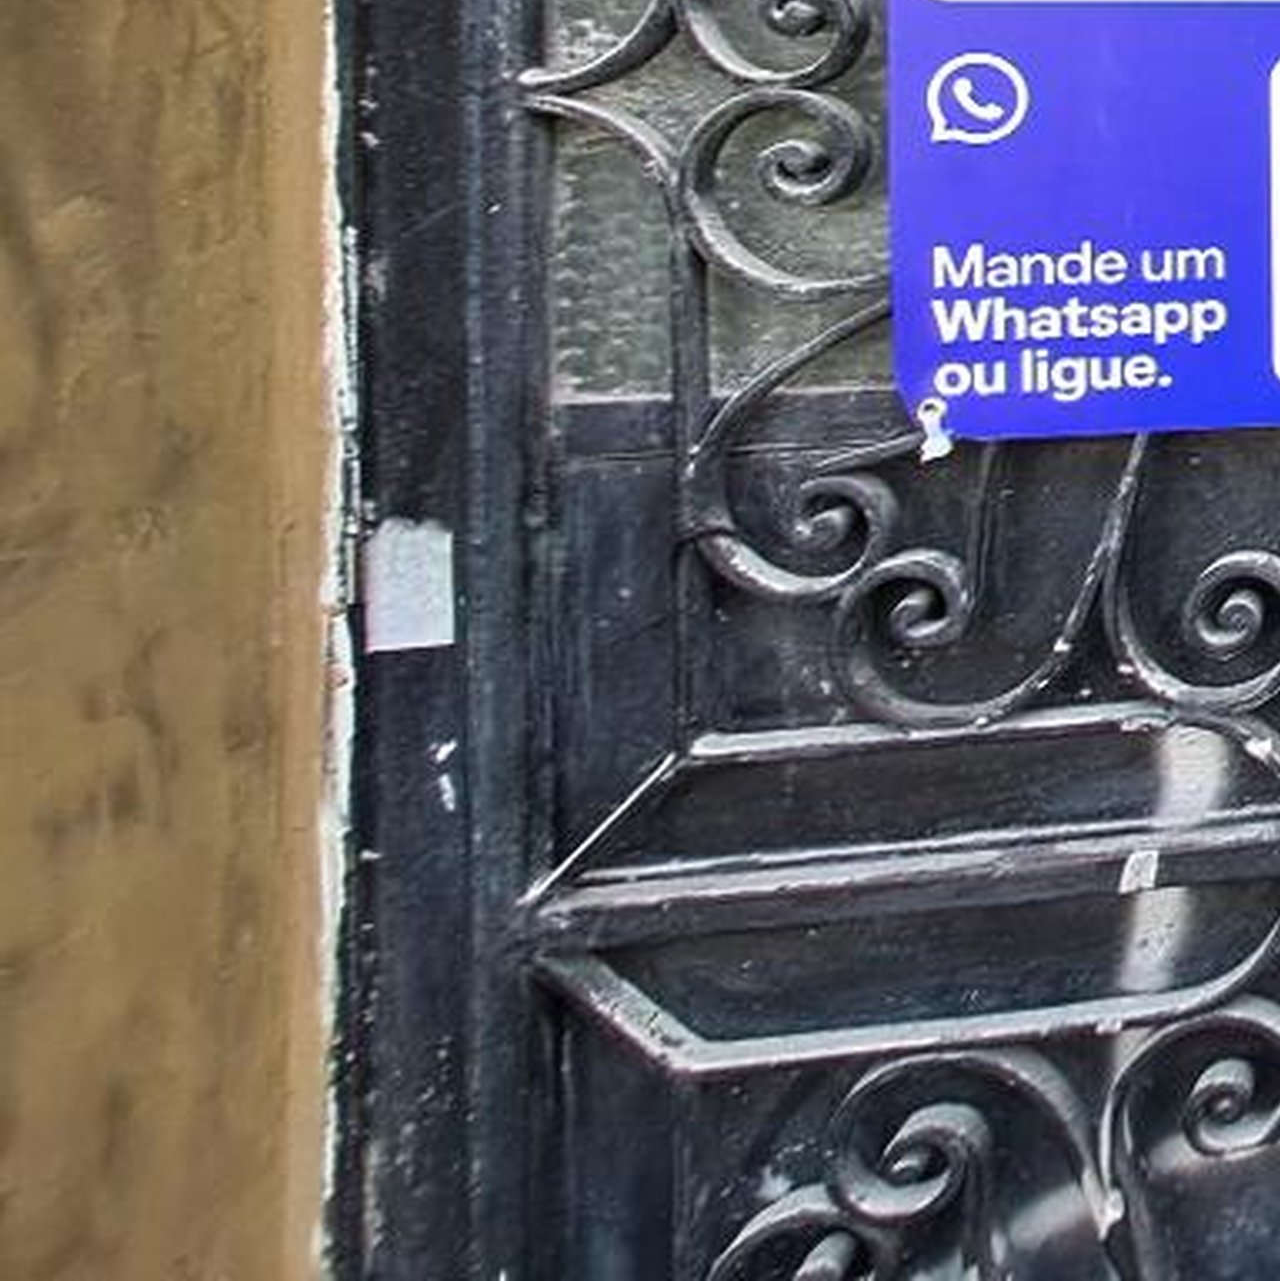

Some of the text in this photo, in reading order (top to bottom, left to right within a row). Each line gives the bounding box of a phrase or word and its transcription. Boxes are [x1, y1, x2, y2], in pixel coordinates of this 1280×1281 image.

[932, 241, 1226, 290] Mande um
[930, 296, 1228, 346] Whatsapp
[932, 348, 1174, 403] ou ligue.
